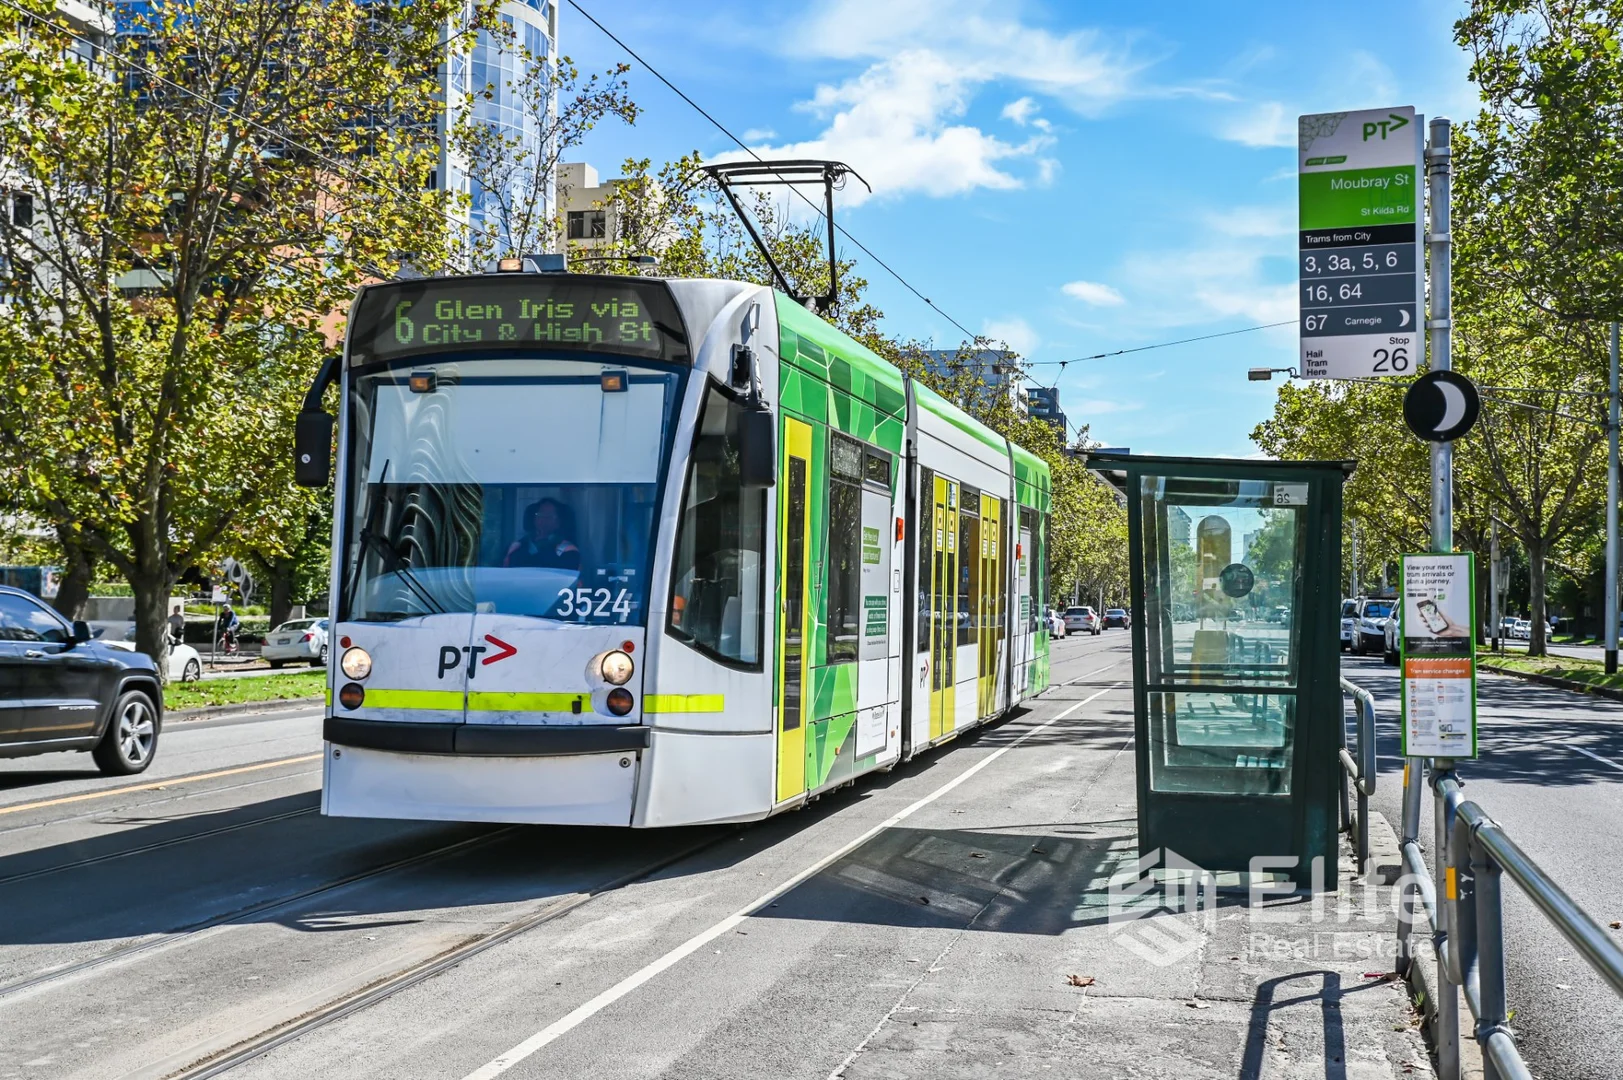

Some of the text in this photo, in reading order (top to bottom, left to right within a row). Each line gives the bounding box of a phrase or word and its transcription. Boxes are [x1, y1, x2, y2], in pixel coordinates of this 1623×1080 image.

[1331, 173, 1409, 190] Moubray St
[1361, 204, 1410, 216] St Kilda Rd
[1305, 231, 1372, 244] Trams from City
[1305, 251, 1398, 274] 3, 3a, 5, 6
[1306, 282, 1363, 303] 16, 64
[395, 297, 639, 344] 6 Glen Iris via
[1305, 314, 1382, 331] 67 Carnegie
[423, 321, 651, 344] City & High St
[1389, 336, 1410, 345] Stop
[1306, 350, 1323, 358] Hail
[1372, 347, 1409, 373] 26
[1306, 359, 1328, 367] Tram
[1306, 368, 1327, 376] Here
[1422, 564, 1435, 572] your
[556, 587, 631, 617] 3524
